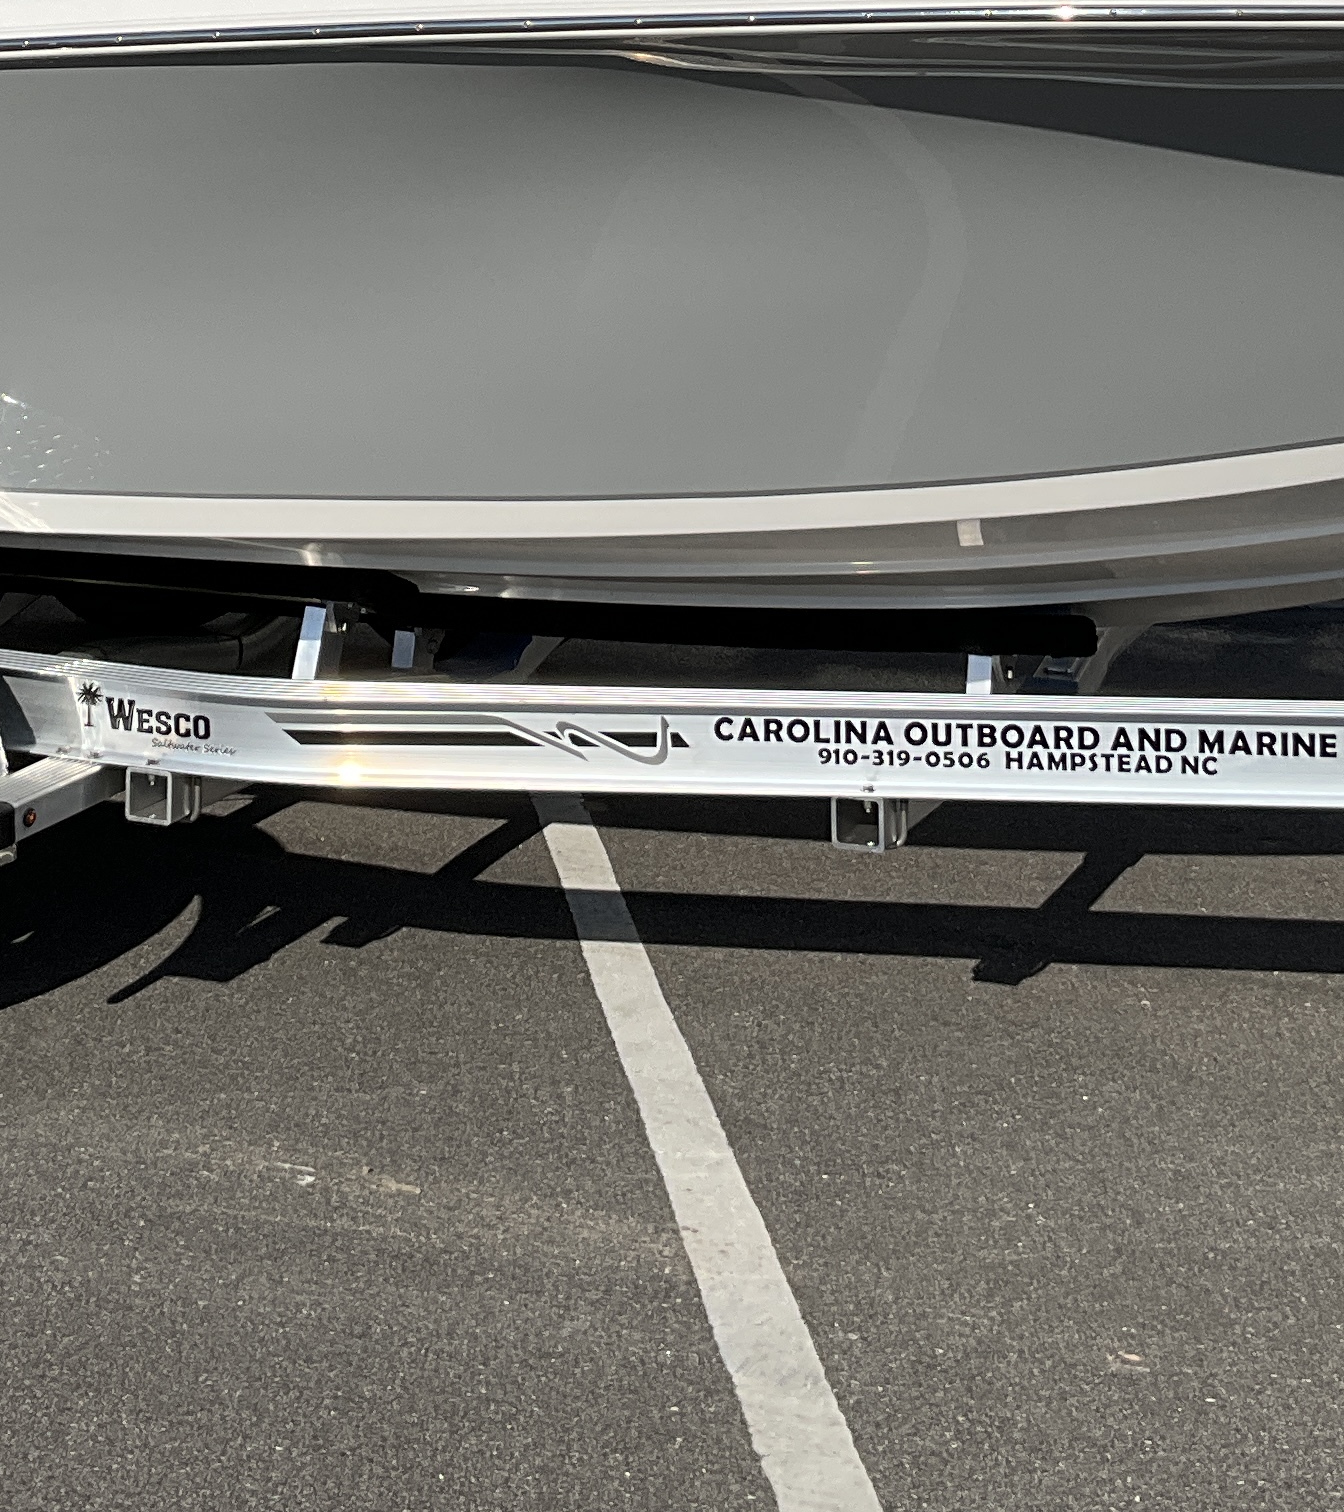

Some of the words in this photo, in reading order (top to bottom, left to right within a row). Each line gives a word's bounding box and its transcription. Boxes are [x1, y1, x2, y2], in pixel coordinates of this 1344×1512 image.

[105, 696, 211, 740] WESCO
[151, 737, 200, 752] Saltwater
[203, 744, 237, 756] Series
[713, 716, 894, 745] CAROLINA
[903, 721, 1101, 751] OUTBOARD
[1110, 726, 1188, 753] AND
[1197, 728, 1338, 758] MARINE
[818, 747, 991, 769] 910-319-0506
[1005, 750, 1173, 774] HAMPSTEAD
[1180, 755, 1219, 776] NC
